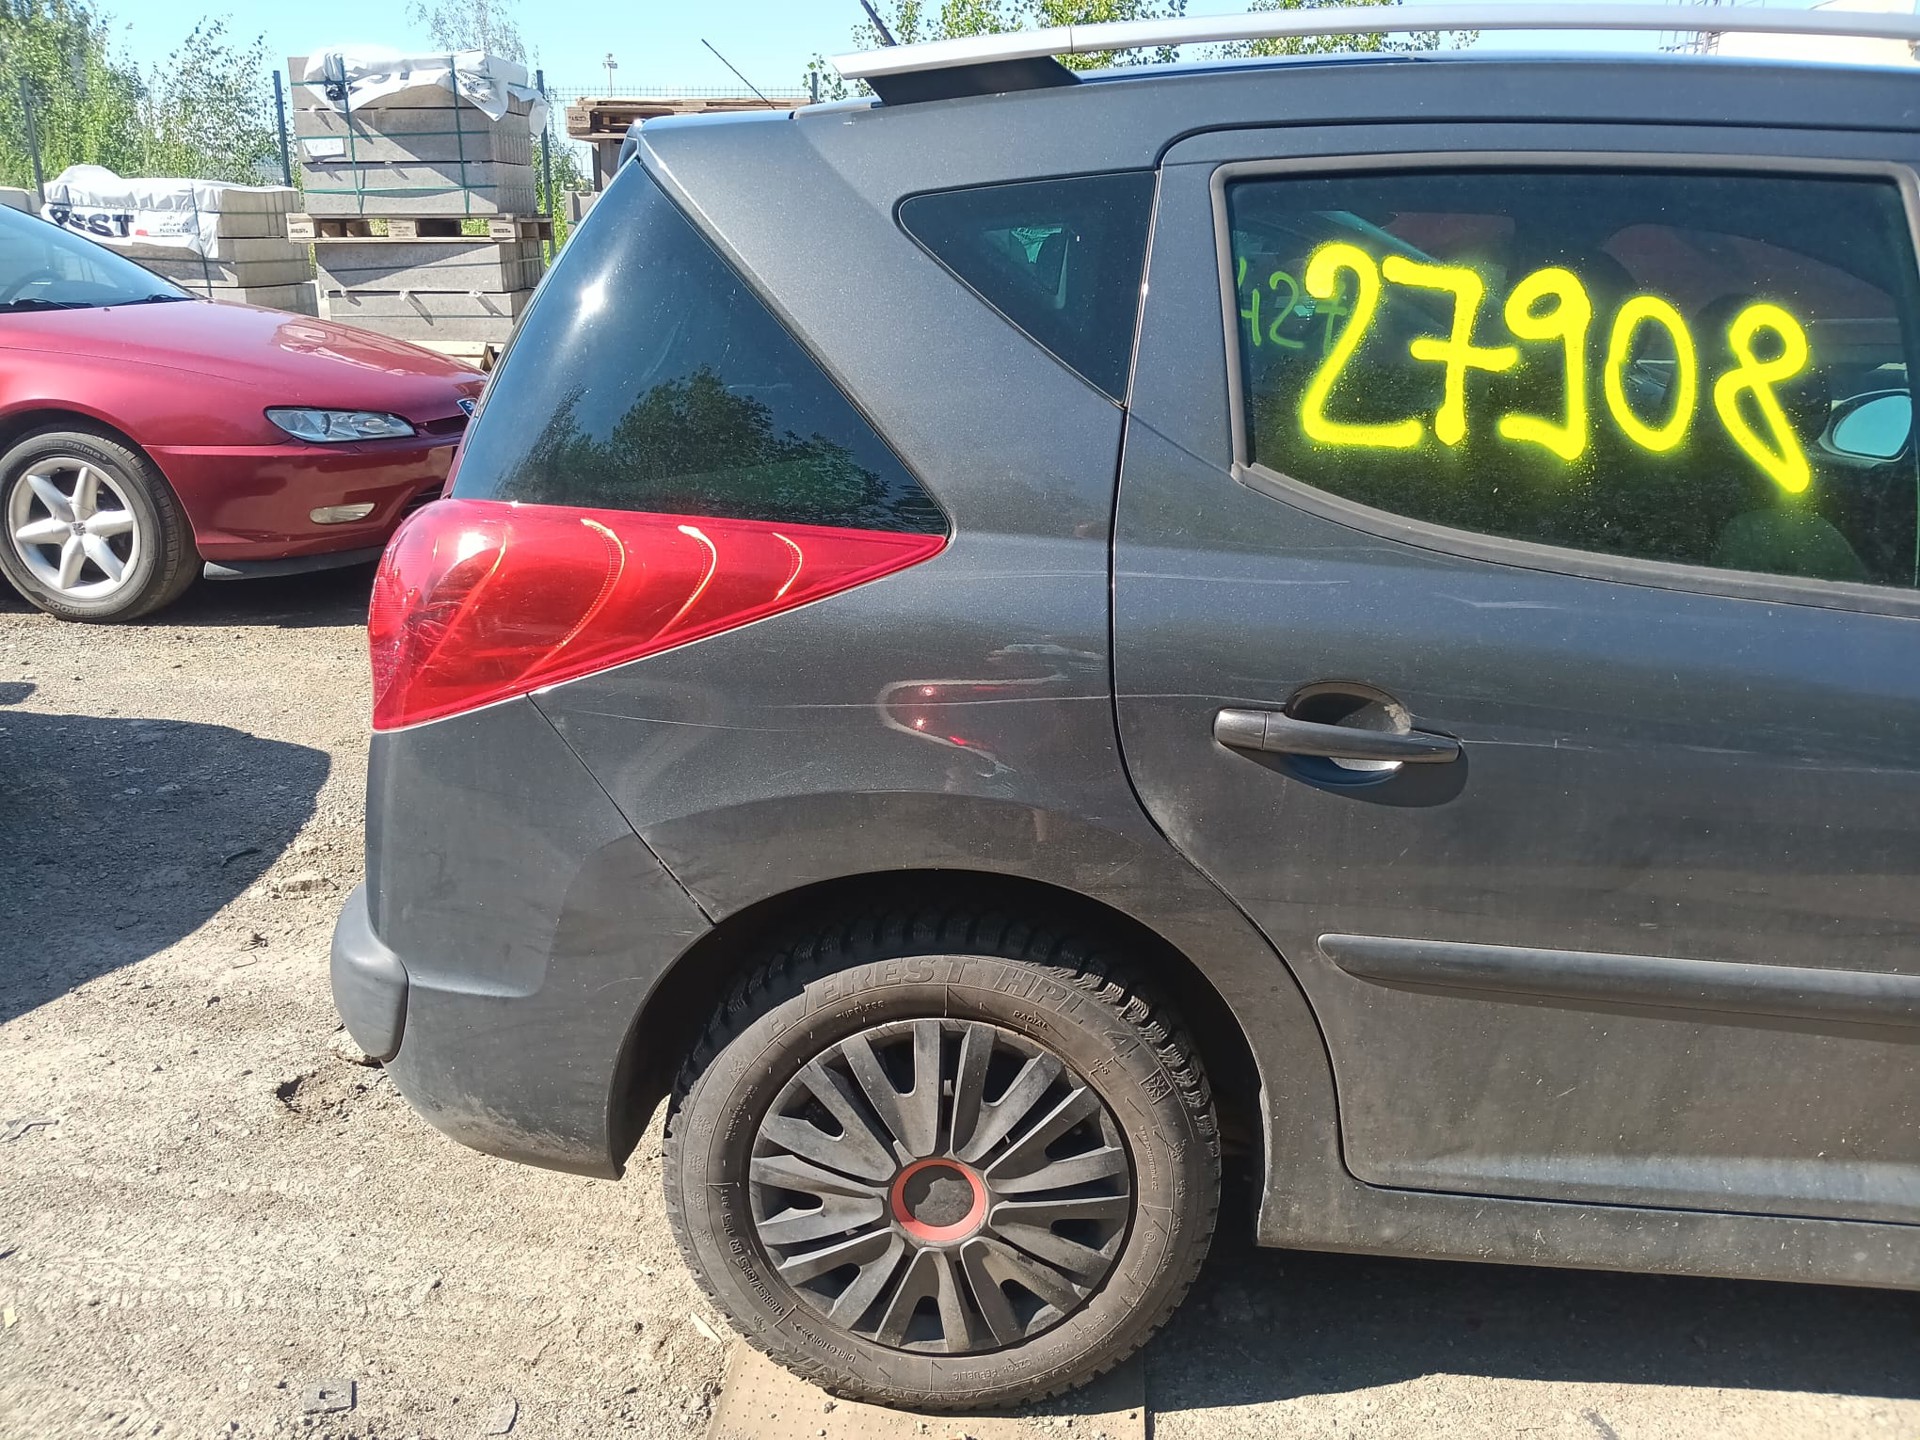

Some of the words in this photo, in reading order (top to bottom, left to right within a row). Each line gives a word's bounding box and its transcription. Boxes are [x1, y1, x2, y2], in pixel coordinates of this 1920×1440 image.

[1299, 241, 1812, 497] 27908
[766, 957, 979, 1043] EVEREST
[1012, 1009, 1050, 1031] RADIAL
[720, 1212, 736, 1237] 15
[728, 1238, 743, 1255] R
[737, 1254, 785, 1317] 185/55
[810, 1332, 857, 1364] DIRECTION
[951, 1368, 1001, 1383] REPUBLIC
